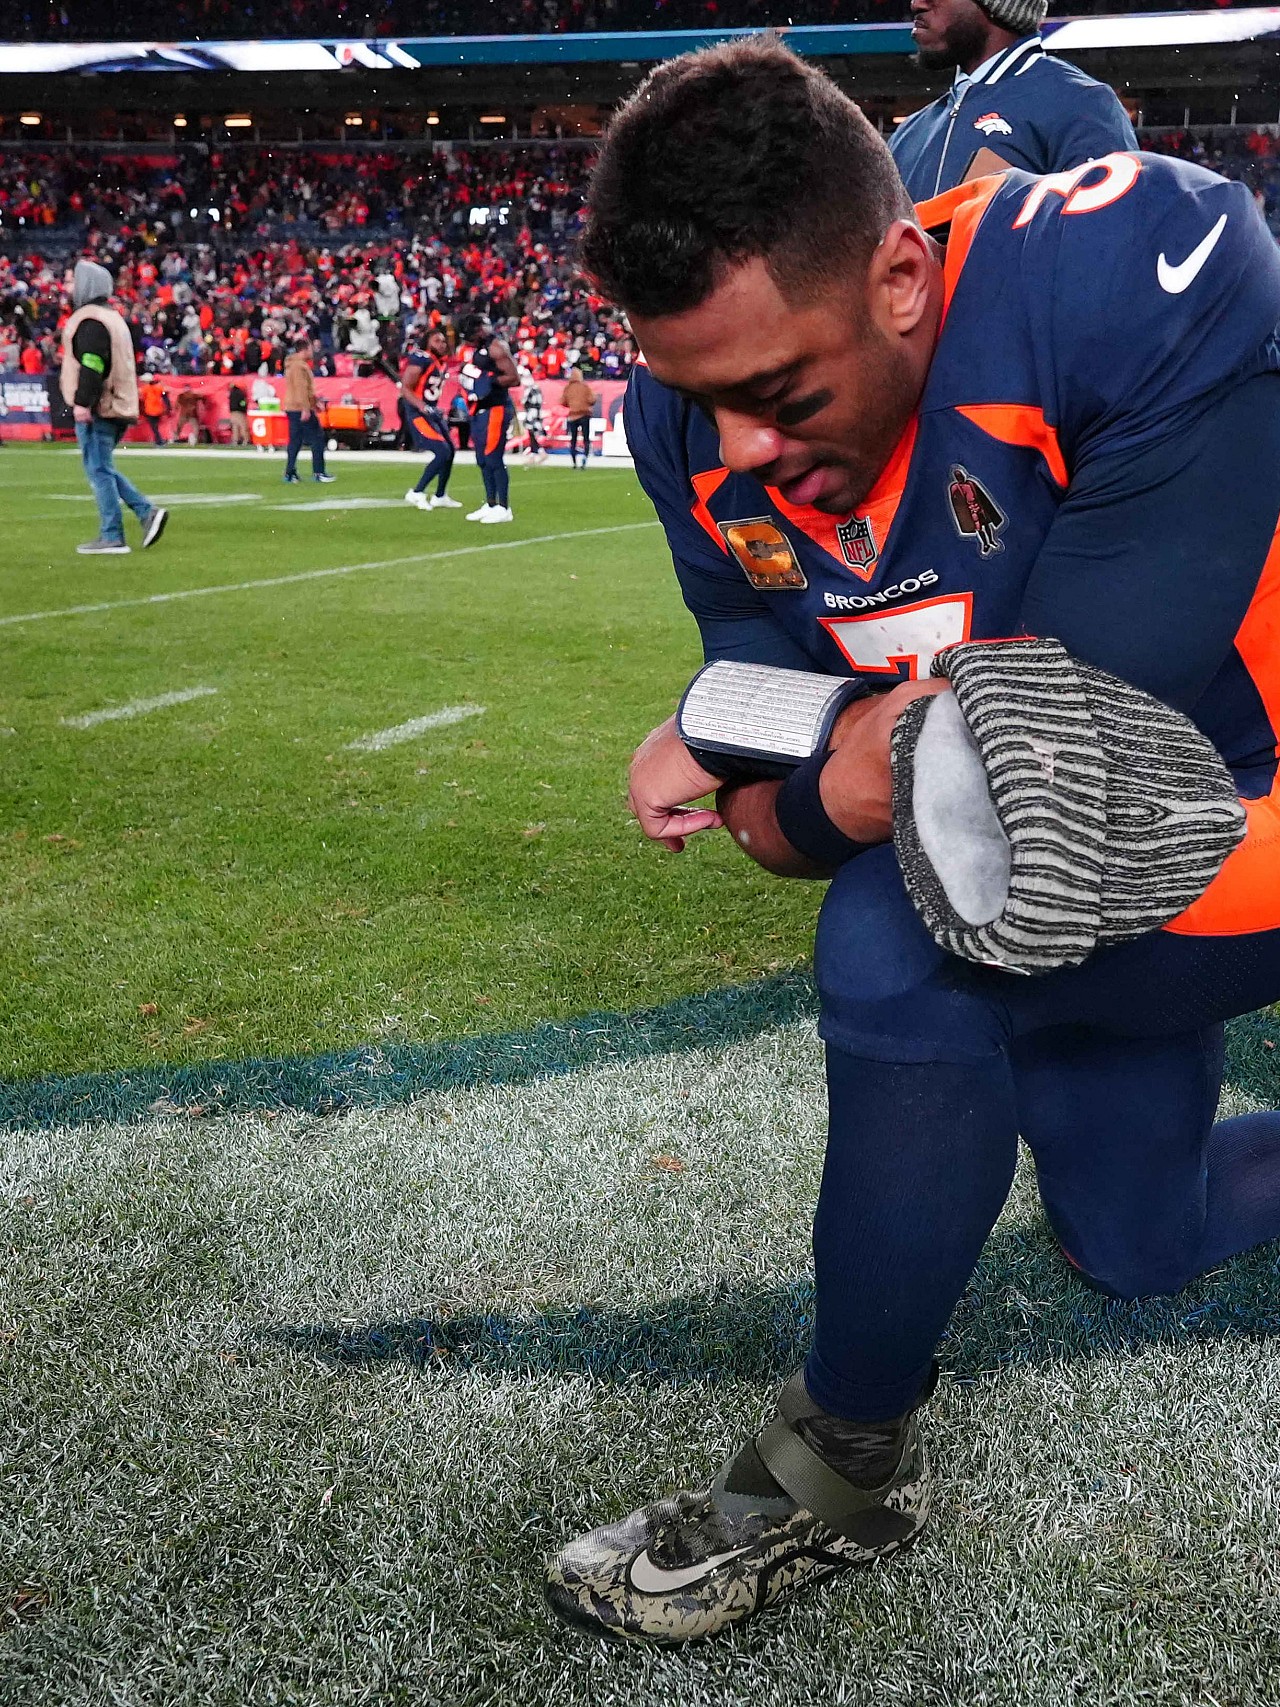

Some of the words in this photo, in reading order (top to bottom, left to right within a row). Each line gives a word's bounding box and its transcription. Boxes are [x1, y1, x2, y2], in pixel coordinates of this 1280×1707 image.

[727, 523, 792, 575] C
[844, 538, 873, 562] NFL
[823, 568, 939, 611] BRONCOS
